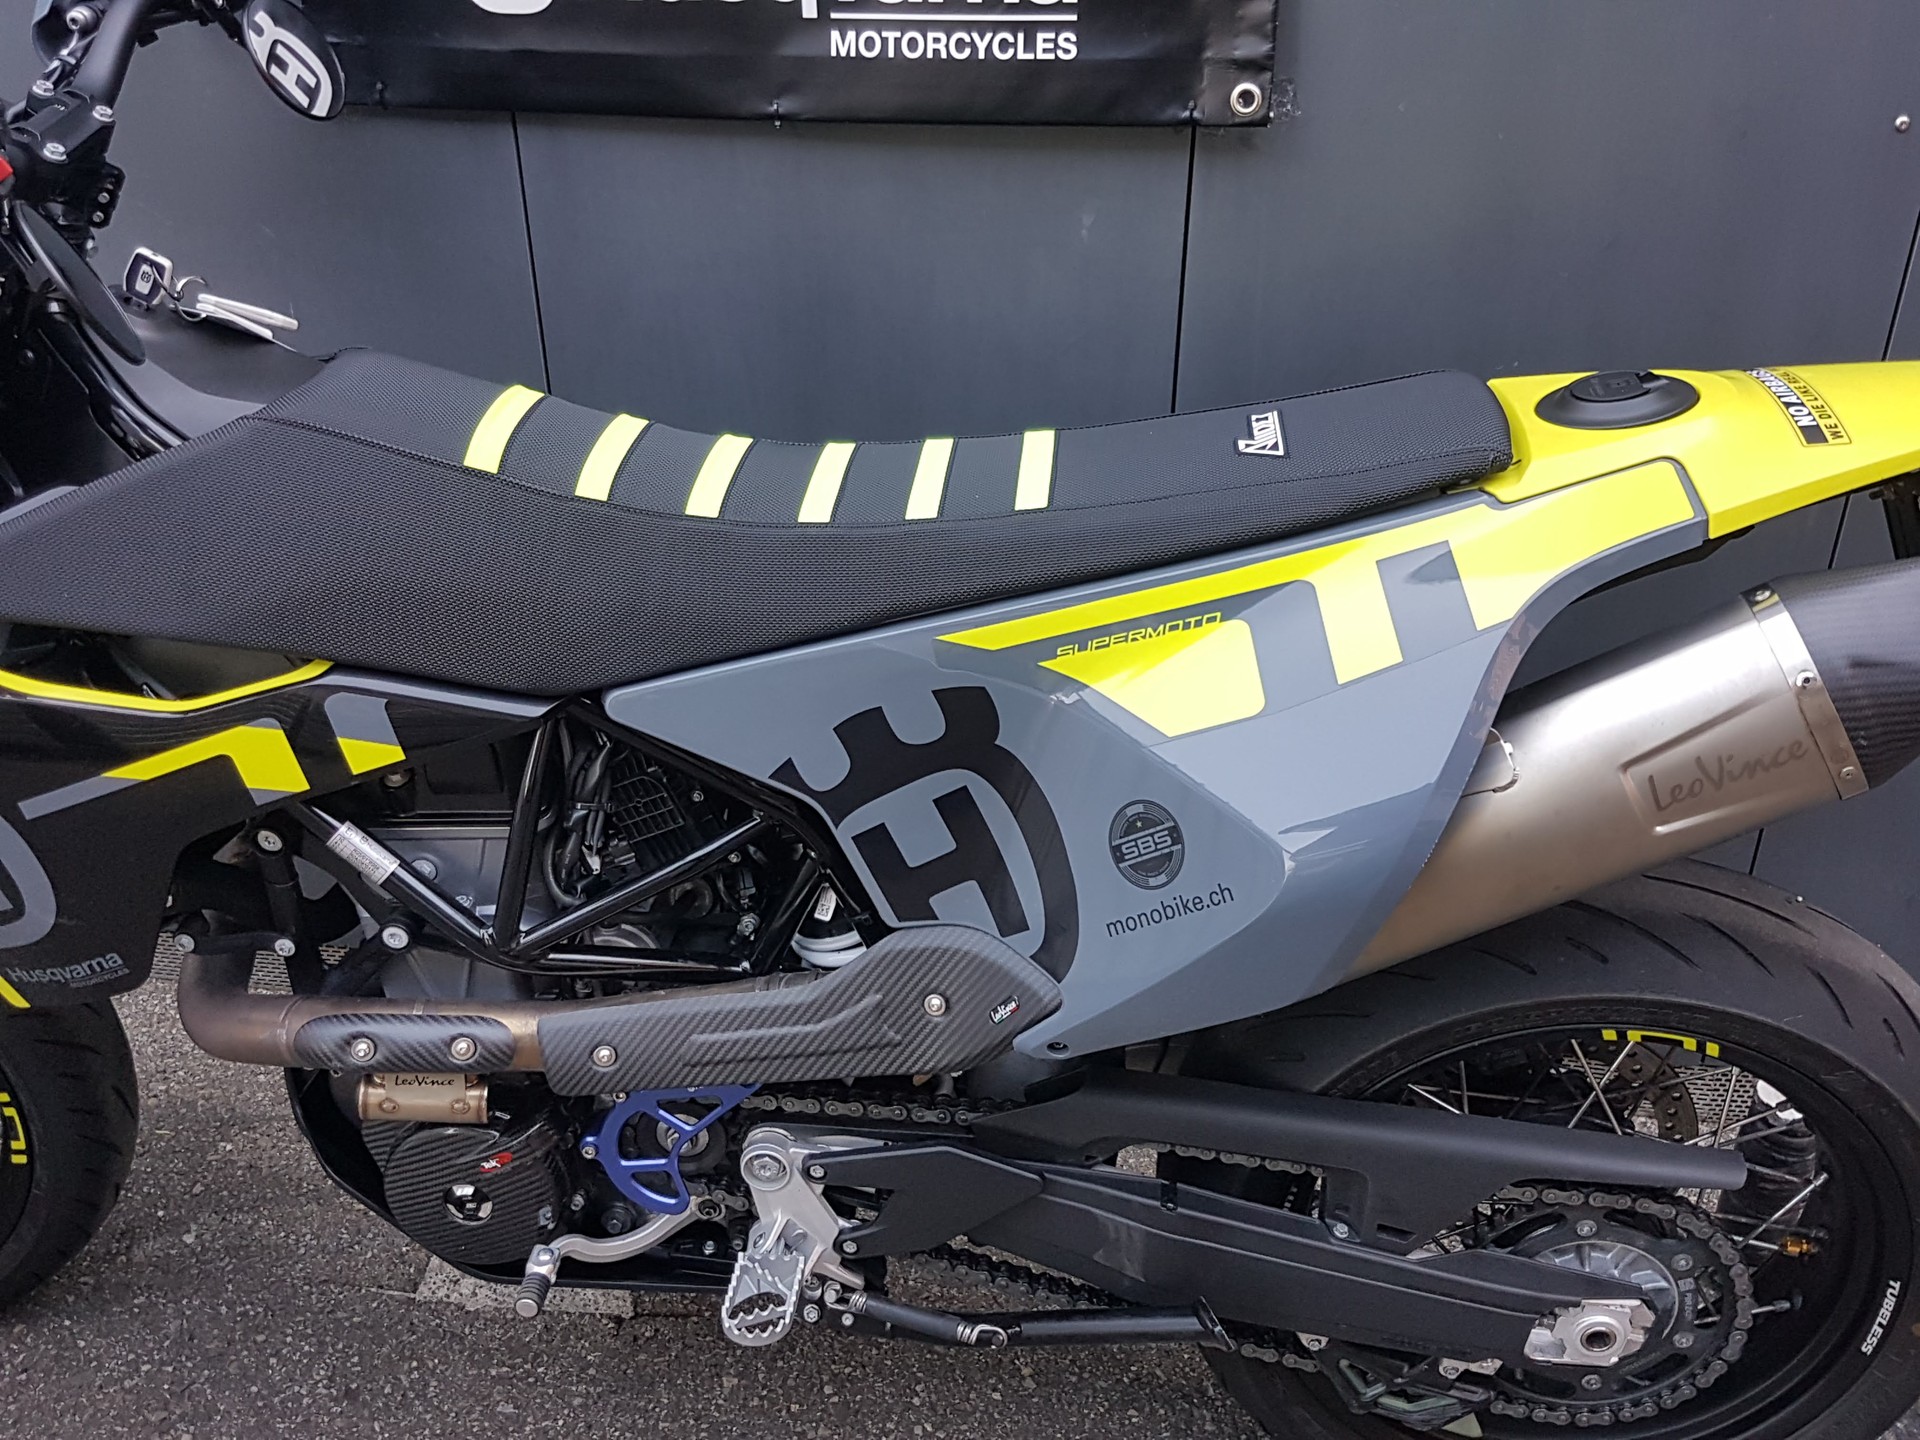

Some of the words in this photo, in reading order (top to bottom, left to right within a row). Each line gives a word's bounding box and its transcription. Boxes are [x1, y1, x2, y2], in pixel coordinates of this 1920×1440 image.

[830, 30, 1078, 60] MOTORCYCLES
[1794, 384, 1819, 402] LIKE
[1787, 405, 1818, 427] NO
[1810, 403, 1832, 420] DIE
[1824, 422, 1844, 440] WE
[1056, 611, 1222, 660] SUPERMOTO
[1647, 739, 1808, 812] LeoVince
[1121, 830, 1173, 860] SBS
[1106, 883, 1235, 938] monobike.ch
[6, 952, 124, 983] Husqvarna
[395, 1074, 455, 1086] LeoVince
[1861, 1280, 1901, 1356] TUBELESS
